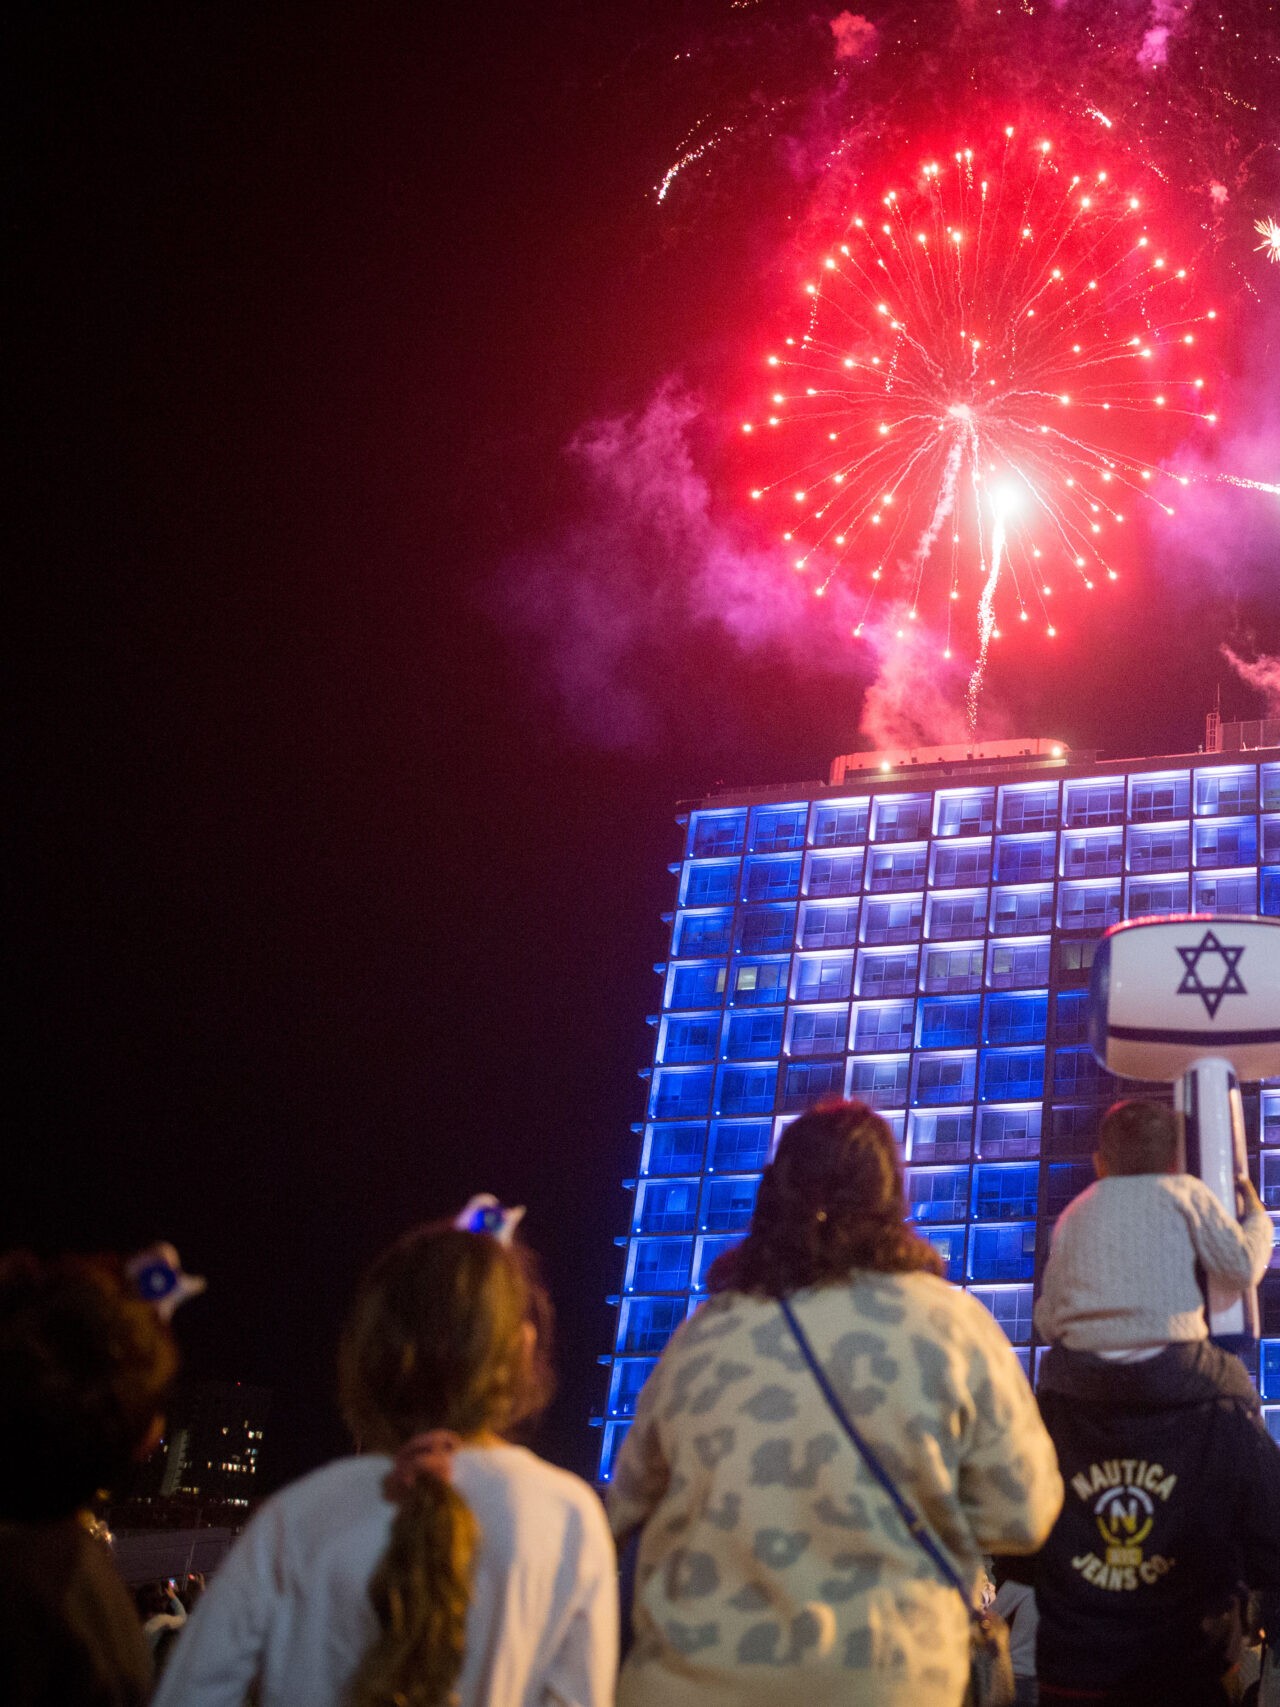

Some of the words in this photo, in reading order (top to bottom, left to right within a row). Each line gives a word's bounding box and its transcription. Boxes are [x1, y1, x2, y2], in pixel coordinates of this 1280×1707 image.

[1071, 1459, 1178, 1501] NAUTICA
[1110, 1499, 1138, 1533] N
[1071, 1552, 1138, 1591] JEANS
